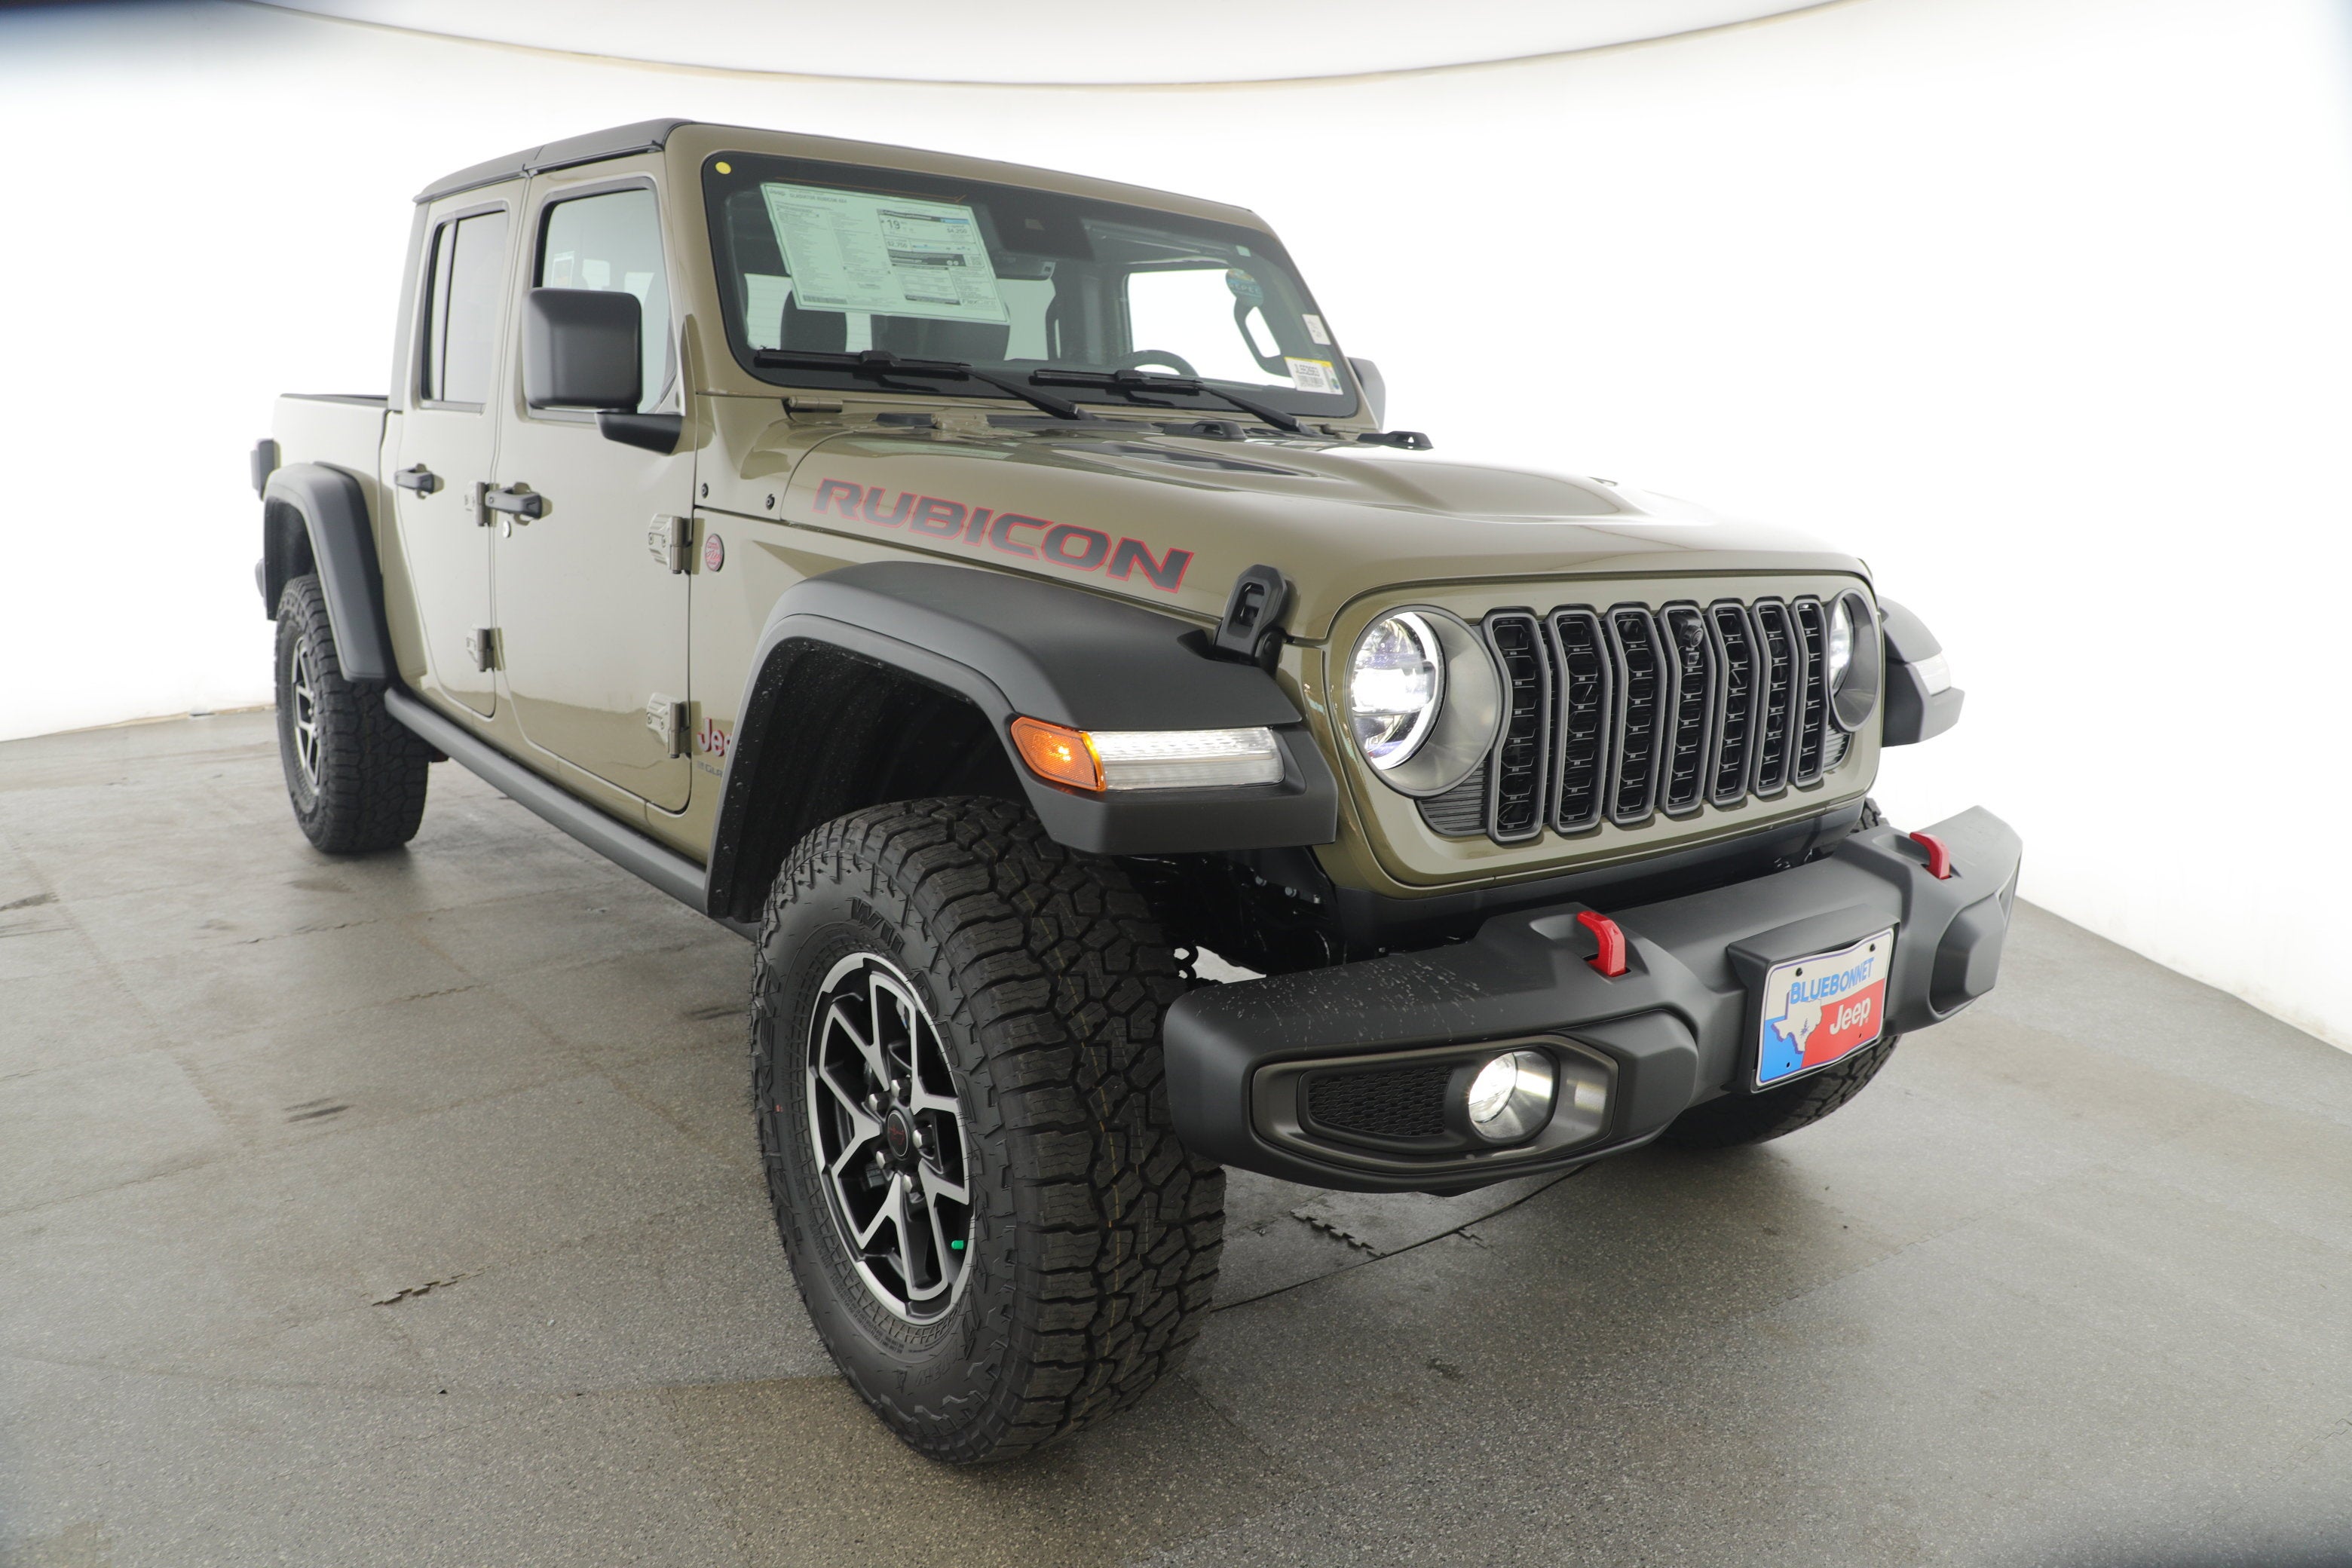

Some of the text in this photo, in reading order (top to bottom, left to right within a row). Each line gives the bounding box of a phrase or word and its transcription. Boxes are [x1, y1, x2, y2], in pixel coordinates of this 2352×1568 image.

[887, 219, 900, 230] 19
[812, 478, 1194, 593] RUBICON
[697, 717, 733, 758] Jee
[1790, 957, 1875, 1005] BLUEBONNET
[1829, 997, 1871, 1036] Jeep
